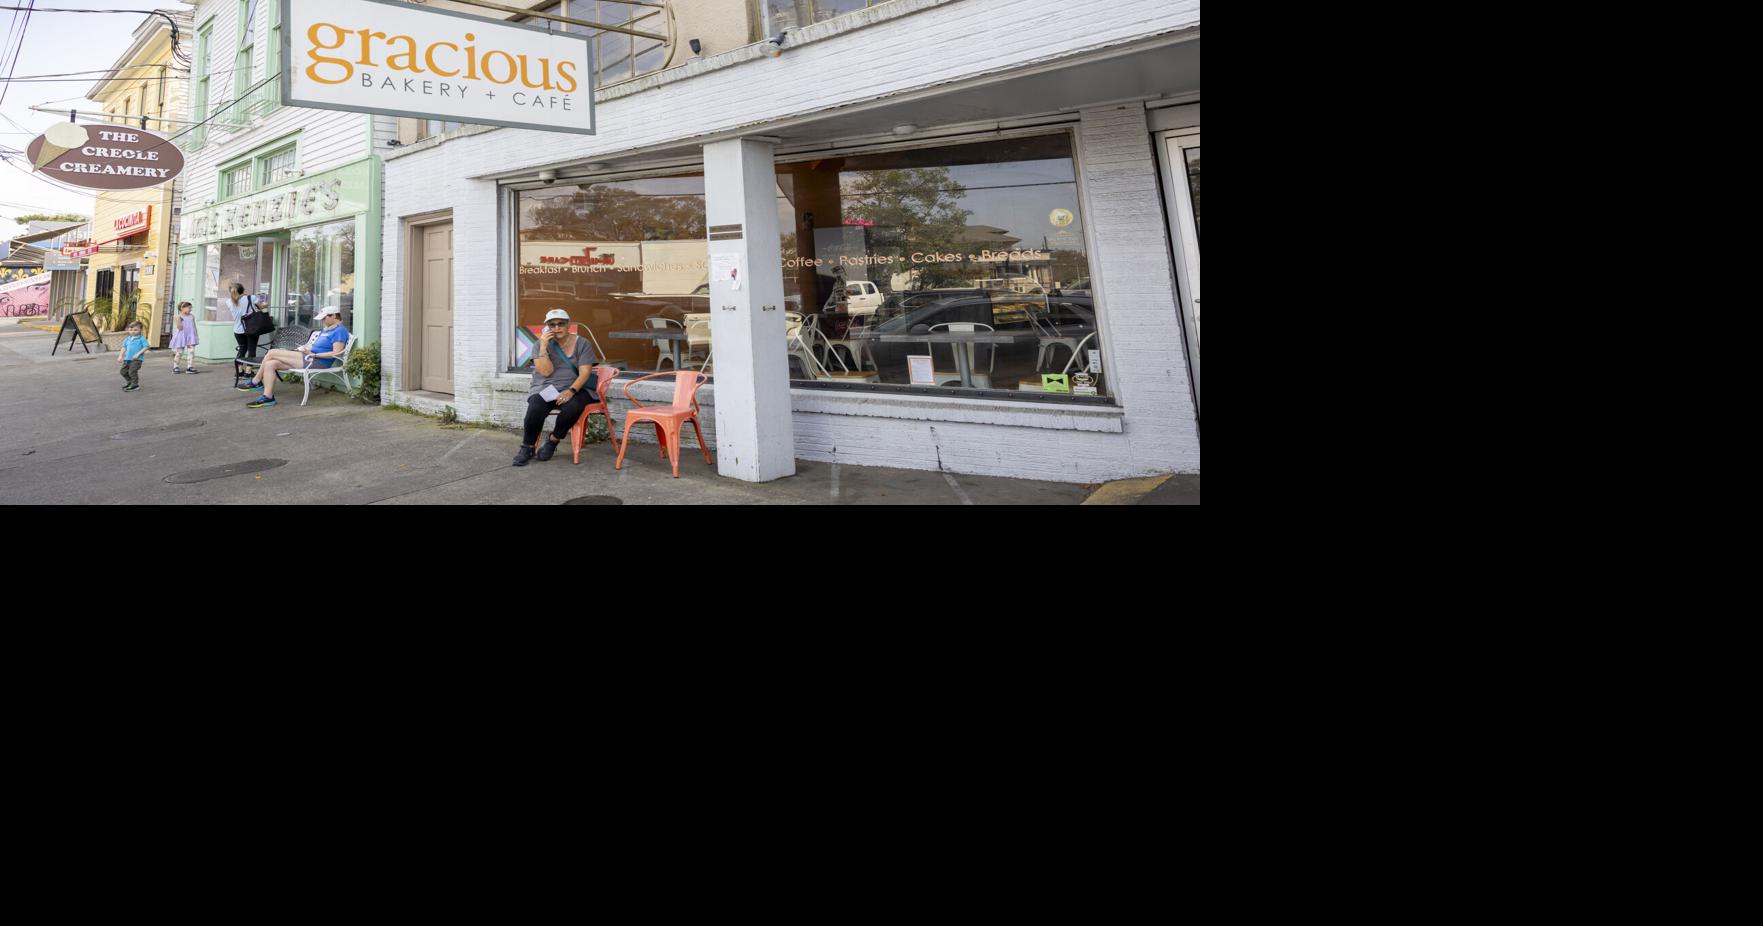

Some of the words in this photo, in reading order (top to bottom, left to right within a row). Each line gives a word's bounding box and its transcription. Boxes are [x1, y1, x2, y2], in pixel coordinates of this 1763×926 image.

[305, 22, 578, 93] gracious
[361, 72, 468, 99] BAKERY
[512, 91, 572, 111] CAFÉ
[99, 131, 139, 143] THE
[81, 146, 159, 161] CREOLE
[60, 162, 170, 178] CREAMERY
[840, 253, 894, 267] Pastries
[911, 252, 963, 263] Cakes
[981, 248, 1042, 260] Breads
[519, 265, 561, 275] Breakfast
[571, 264, 607, 274] Brunch
